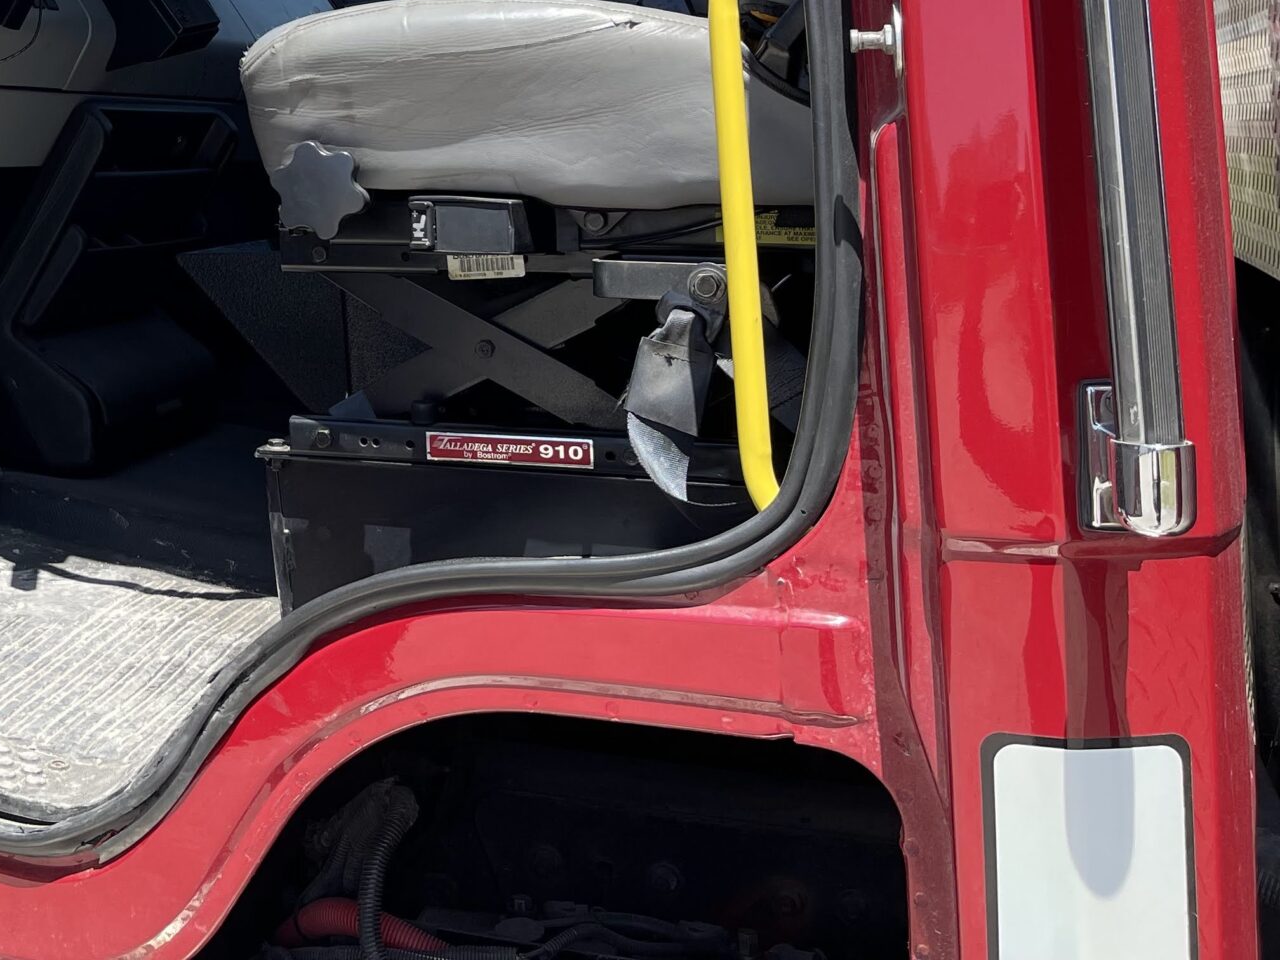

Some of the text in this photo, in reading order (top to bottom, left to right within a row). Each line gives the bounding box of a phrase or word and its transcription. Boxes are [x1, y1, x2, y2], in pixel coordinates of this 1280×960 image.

[436, 436, 584, 460] TALLADEGA SERIES 910
[464, 451, 509, 460] by Bostrom
